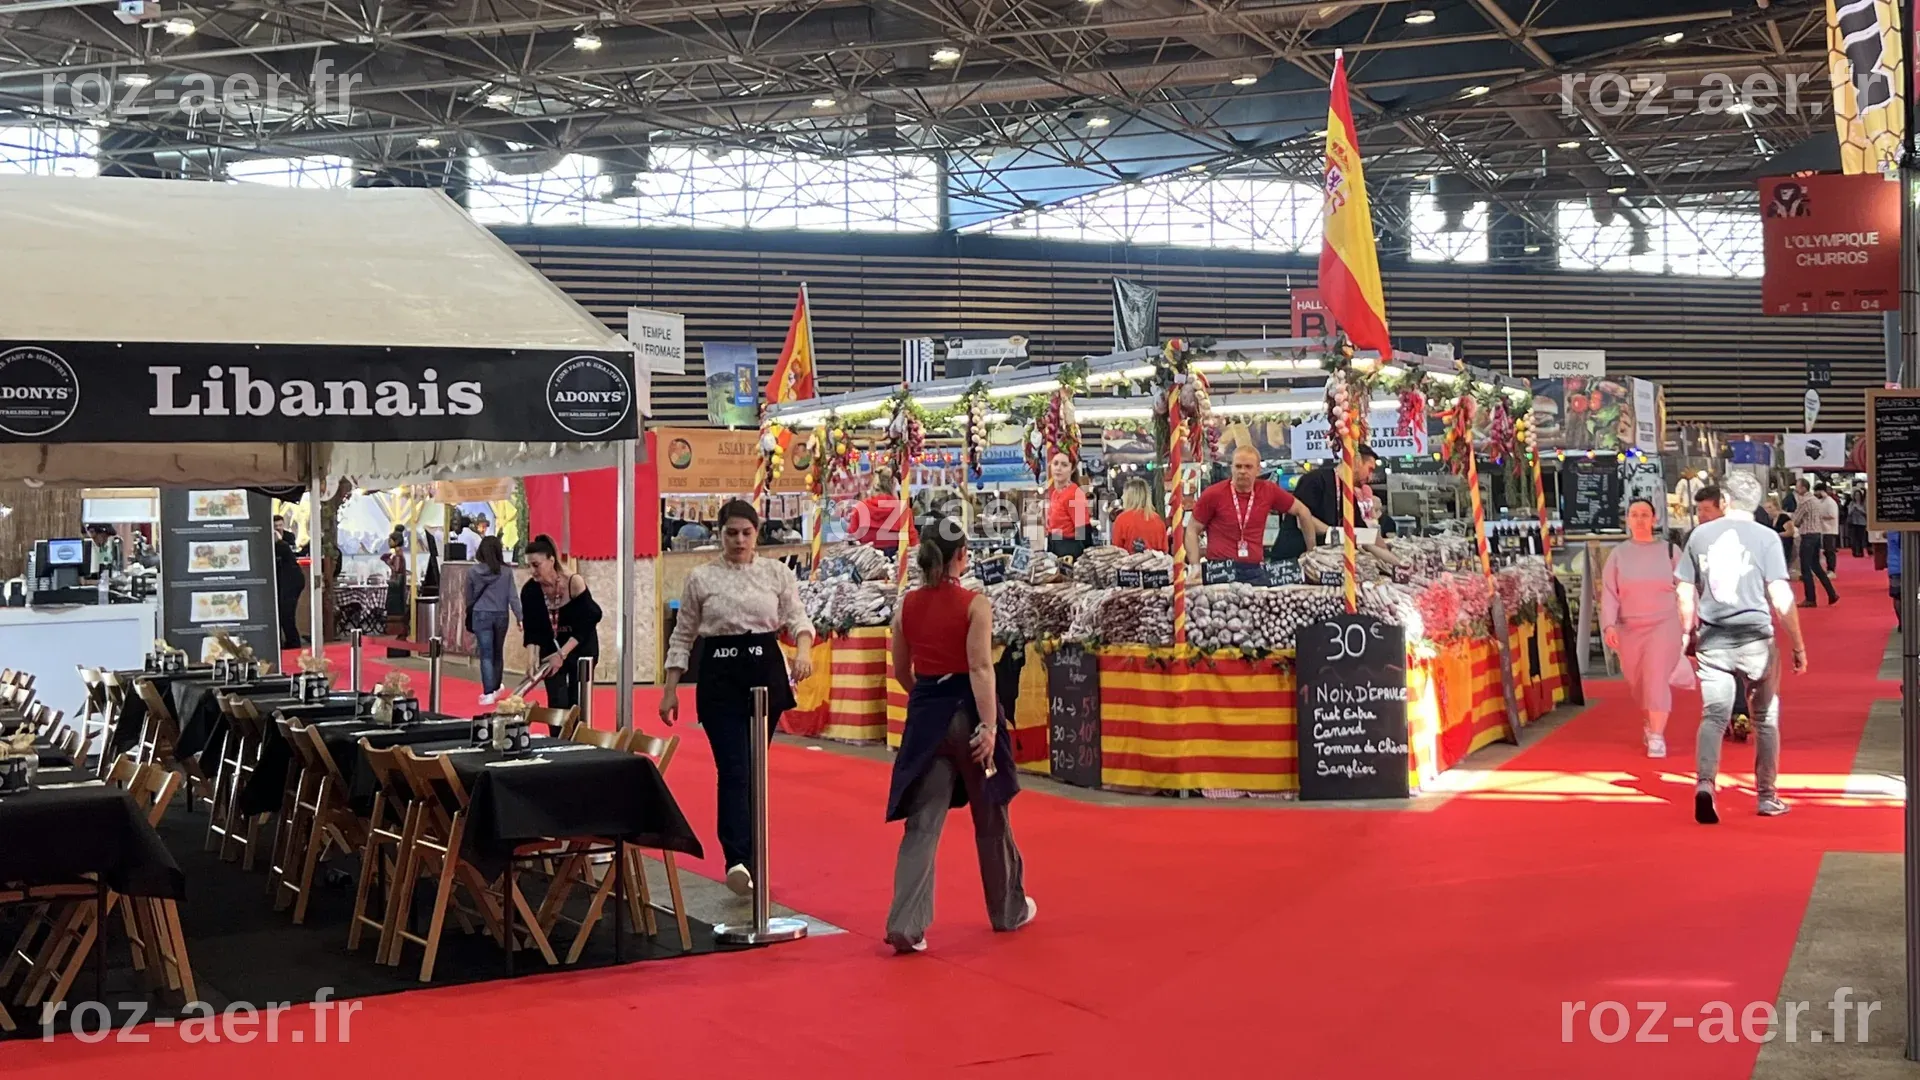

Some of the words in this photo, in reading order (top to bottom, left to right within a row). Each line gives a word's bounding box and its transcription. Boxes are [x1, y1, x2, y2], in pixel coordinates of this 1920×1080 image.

[1784, 231, 1879, 249] L'OLYMPIQUE
[1795, 250, 1869, 267] CHURROS
[1296, 300, 1323, 310] HALL
[1831, 301, 1841, 311] C
[1860, 299, 1880, 309] 04
[641, 325, 672, 341] TEMPLE
[644, 343, 681, 359] FROMAGE
[1553, 361, 1590, 371] QUERCY
[148, 365, 485, 417] Libanais
[554, 391, 622, 403] ADONYS
[717, 443, 746, 456] ASIAN
[1306, 440, 1322, 450] DE
[1370, 437, 1415, 449] ODUITS
[712, 646, 763, 658] ADOYS
[1051, 695, 1065, 716] 12
[1053, 724, 1066, 742] 30
[1313, 723, 1367, 740] Canard
[1313, 742, 1362, 756] Tomme
[1363, 739, 1378, 755] de
[1052, 748, 1066, 771] 70
[1316, 759, 1377, 779] Sanglier
